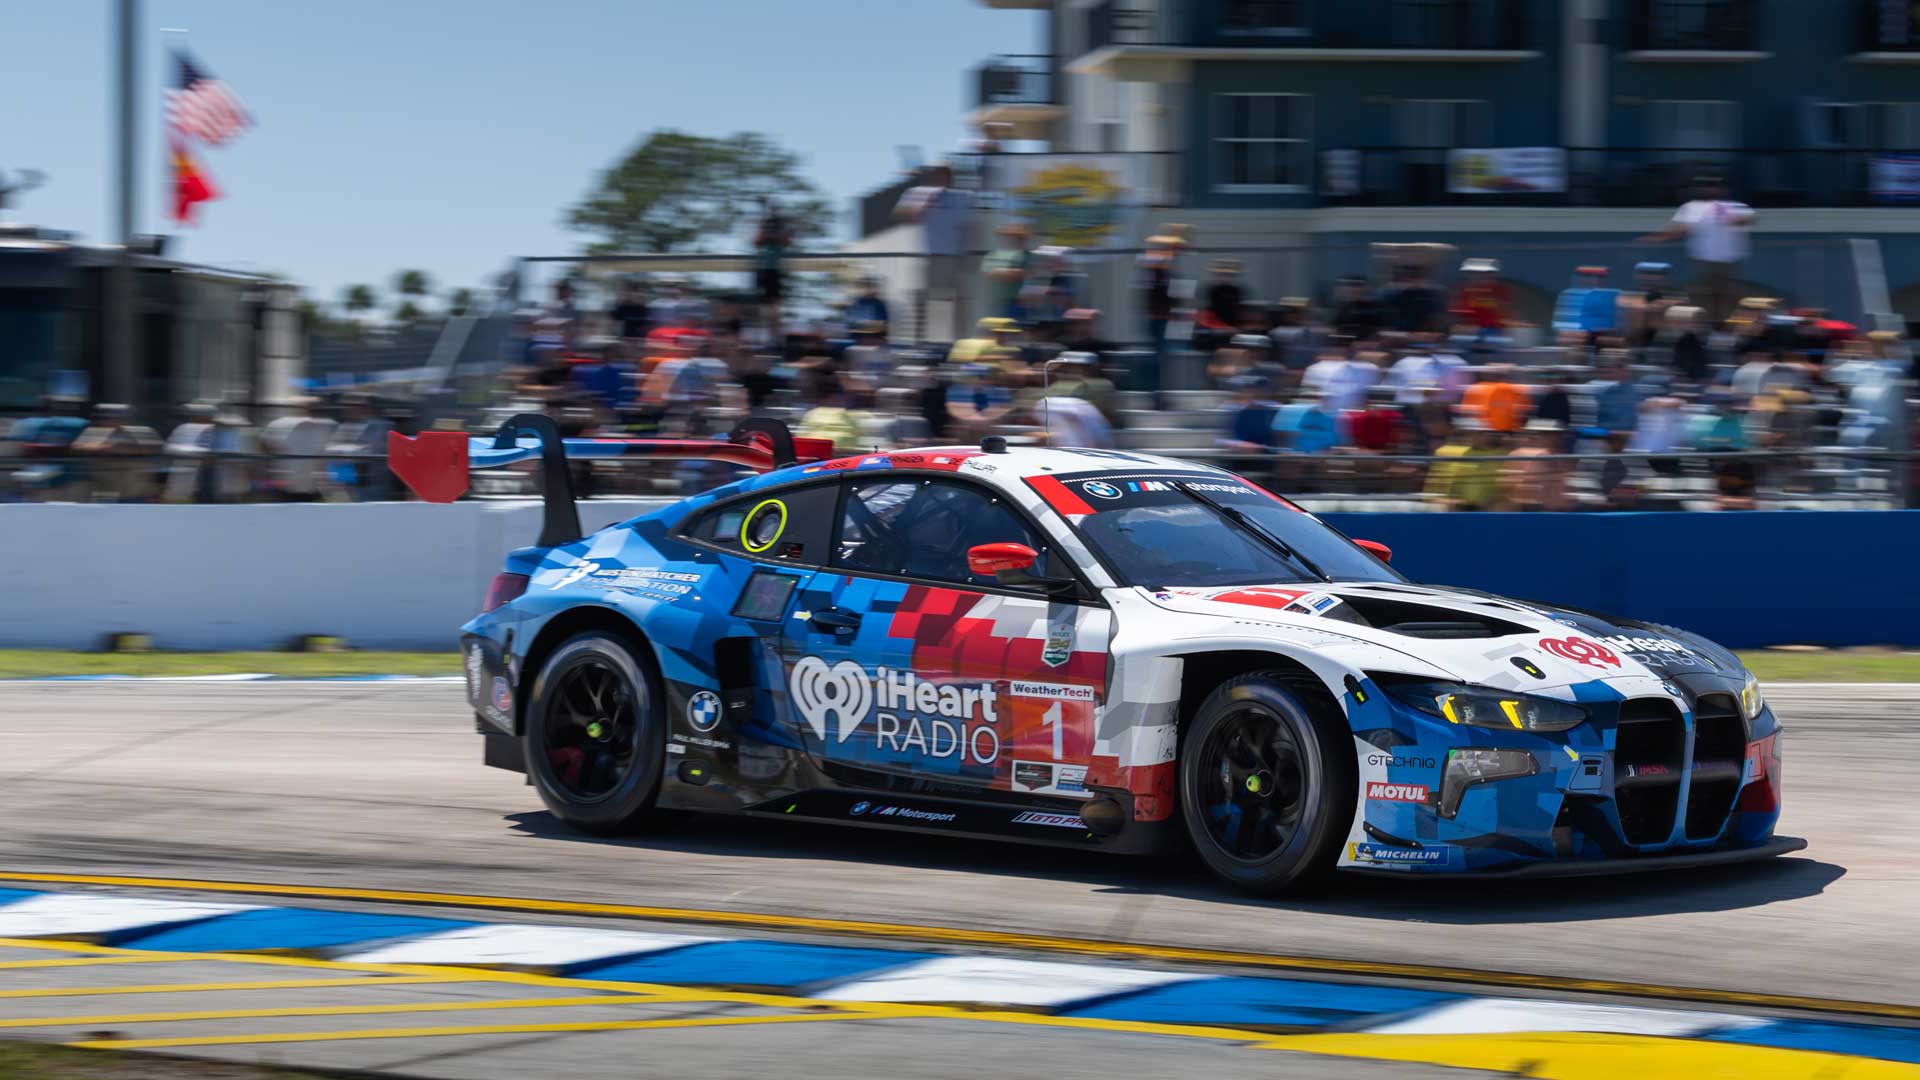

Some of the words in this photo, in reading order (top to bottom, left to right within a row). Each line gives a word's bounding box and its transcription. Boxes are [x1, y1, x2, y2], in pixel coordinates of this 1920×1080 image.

[877, 666, 998, 722] iHeart
[1013, 684, 1091, 697] WeatherTech
[1042, 701, 1063, 760] 1
[876, 713, 999, 764] RADIO
[1369, 784, 1425, 800] MOTUL
[898, 807, 957, 822] Motorsport
[1030, 814, 1063, 824] GTD
[1375, 849, 1440, 860] MICHELIN
